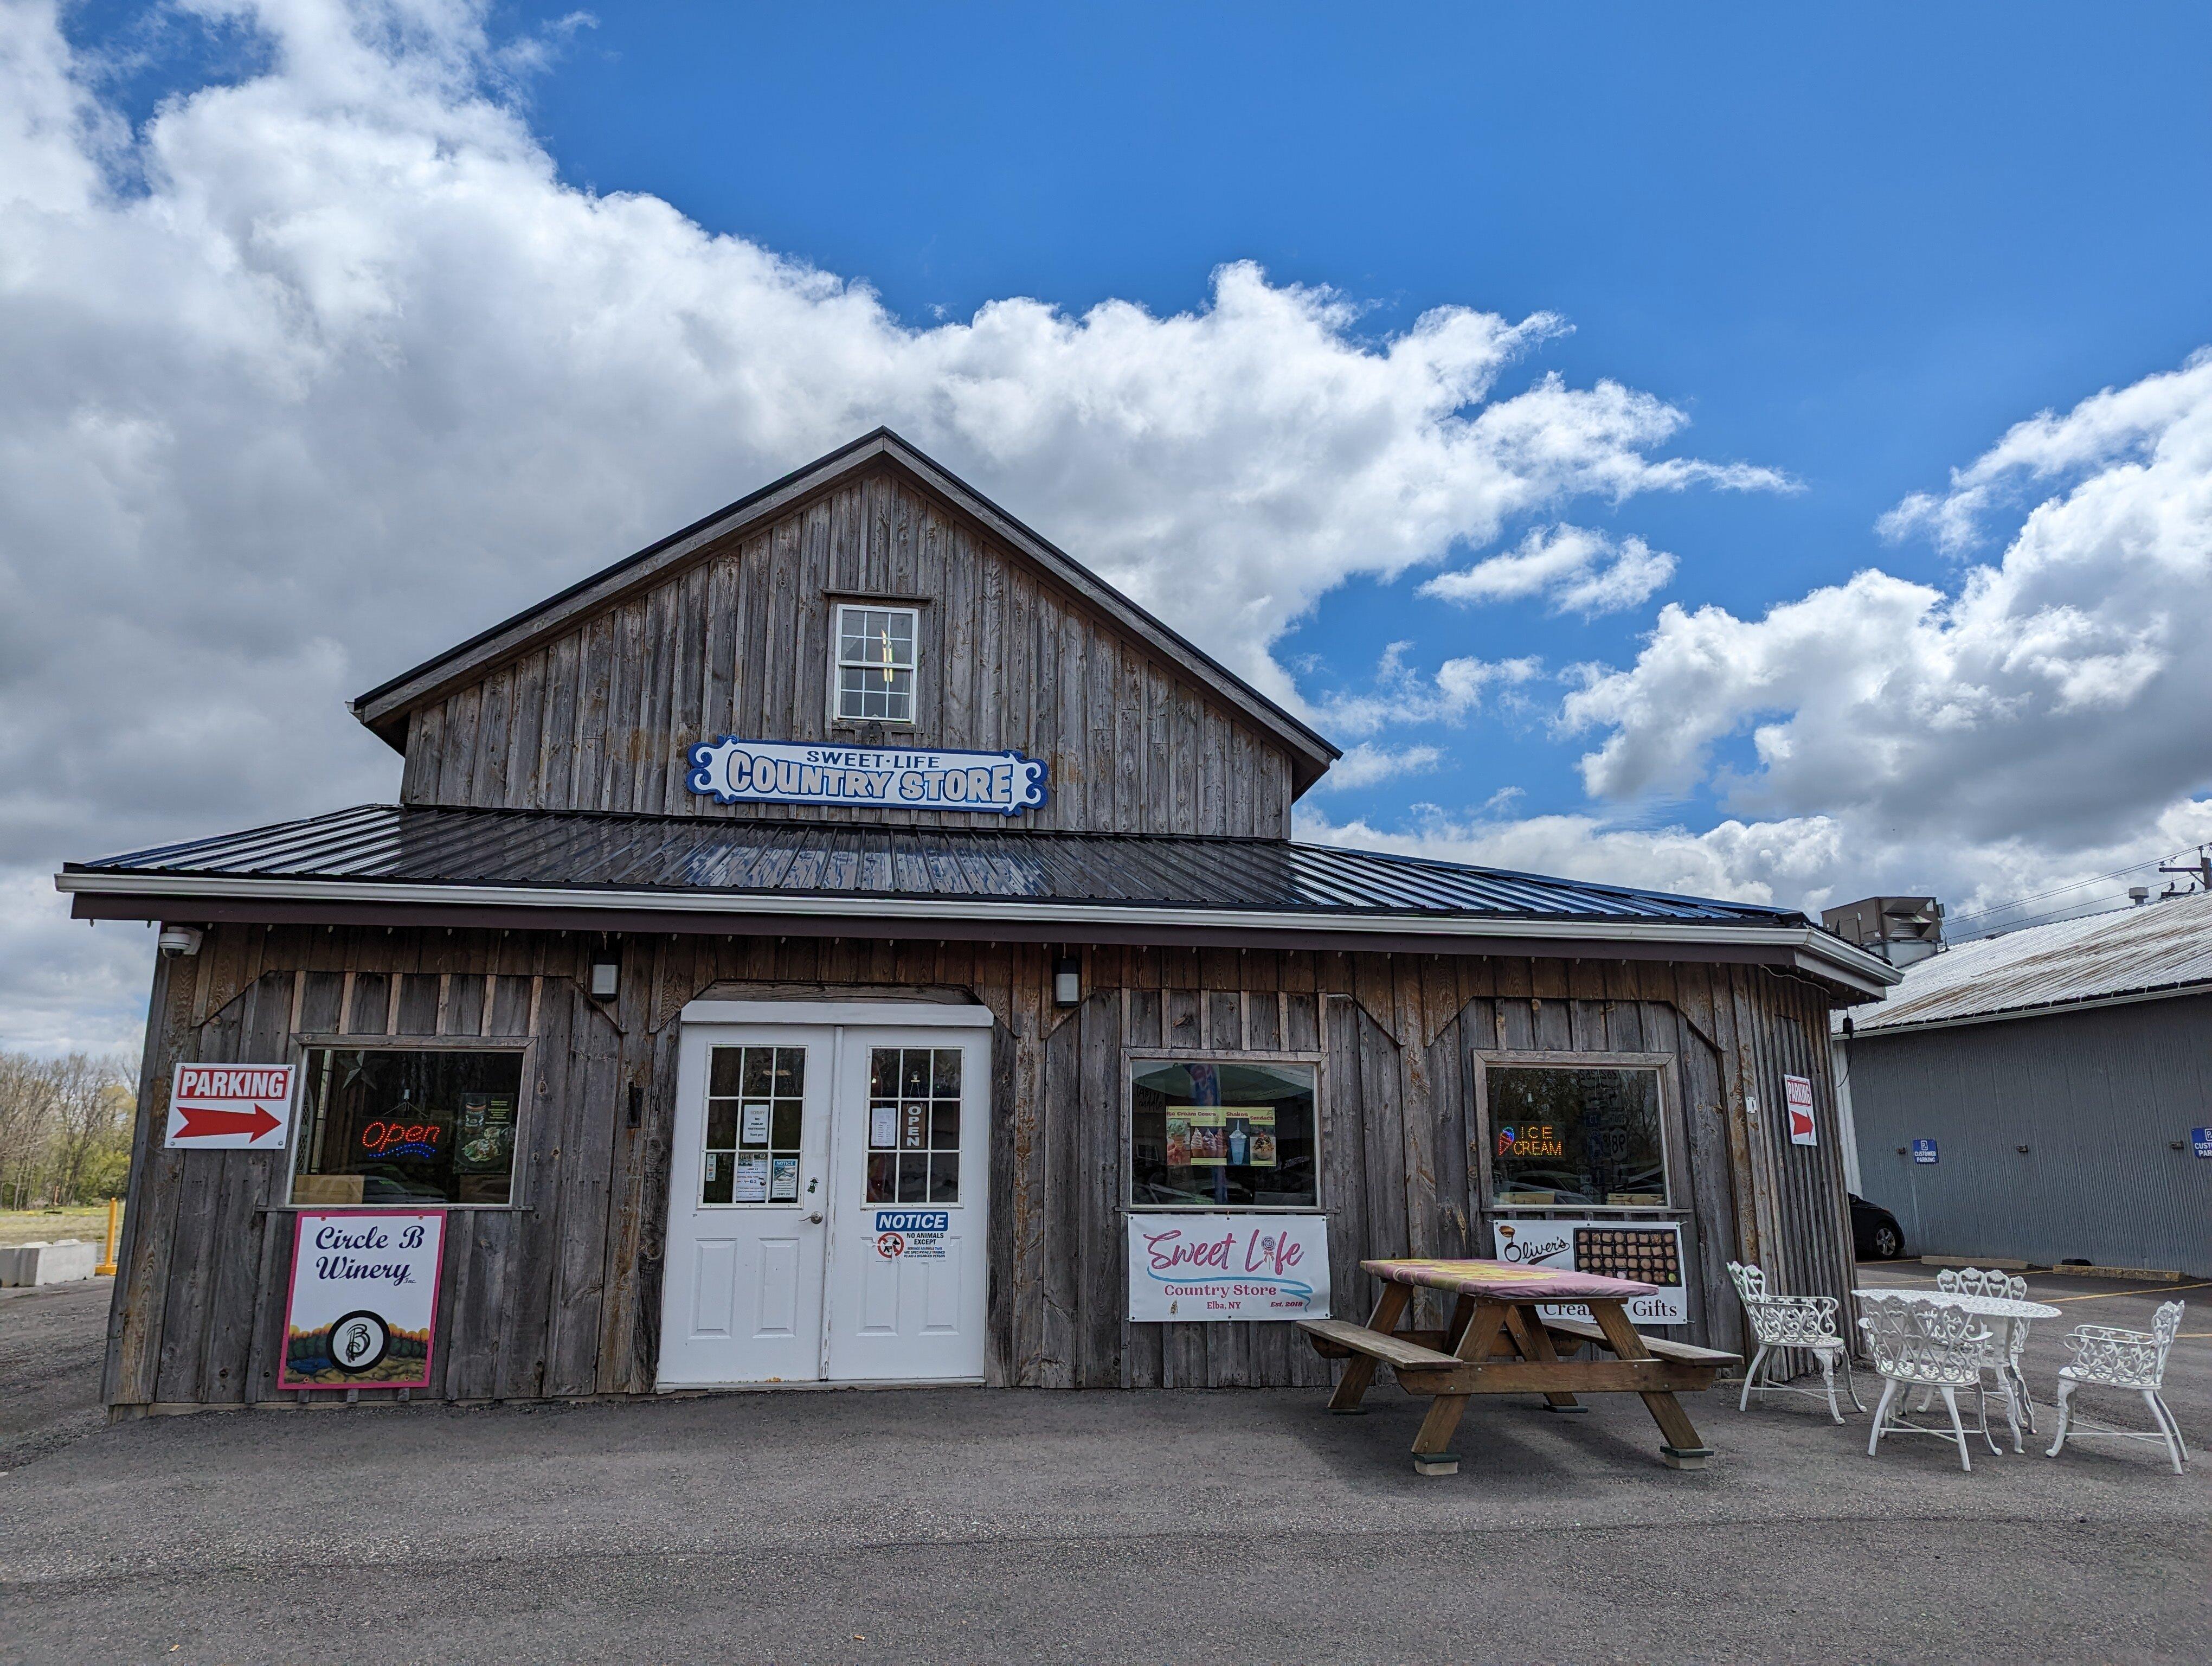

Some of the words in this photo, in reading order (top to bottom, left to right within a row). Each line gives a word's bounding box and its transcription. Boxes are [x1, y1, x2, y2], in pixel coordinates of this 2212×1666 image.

[726, 749, 893, 798] COUNTRY
[900, 764, 1013, 803] STORE
[181, 1071, 285, 1098] PARKING
[1787, 1081, 1811, 1105] PARKING
[362, 1121, 441, 1152] Open
[906, 1106, 922, 1146] OPEN
[1521, 1126, 1552, 1139] ICE
[1513, 1140, 1562, 1155] CREAM
[878, 1214, 947, 1229] NOTICE
[315, 1226, 389, 1250] Circle
[398, 1225, 425, 1249] B
[1504, 1236, 1568, 1263] Oliver's
[1143, 1229, 1237, 1270] Sweet
[1245, 1229, 1304, 1276] Life
[316, 1255, 411, 1286] Winery
[1165, 1284, 1230, 1298] Country
[1233, 1284, 1277, 1296] Store
[1207, 1301, 1227, 1310] Elba,
[1543, 1304, 1593, 1316] Crea
[1632, 1299, 1677, 1317] Gifts
